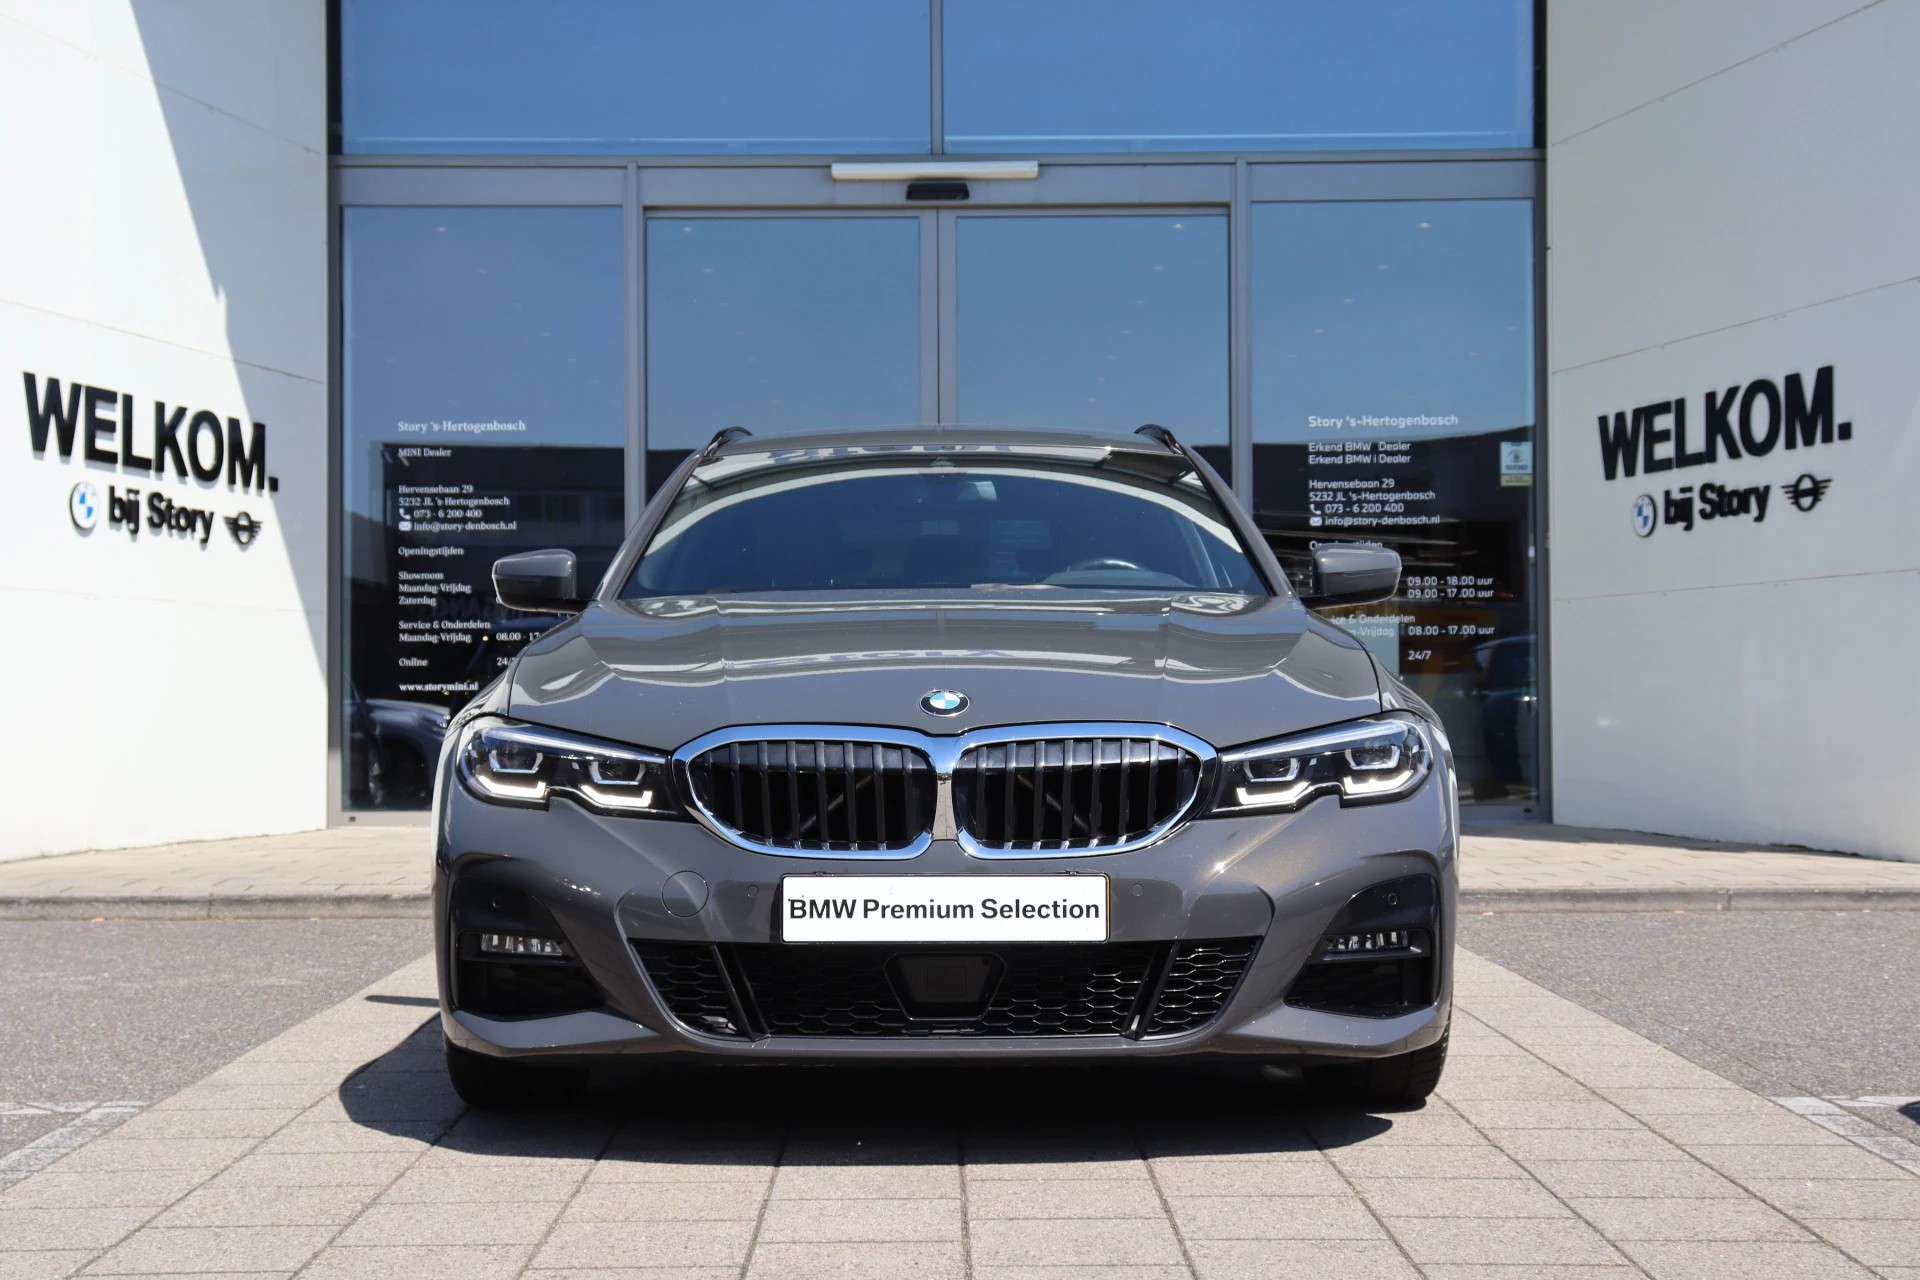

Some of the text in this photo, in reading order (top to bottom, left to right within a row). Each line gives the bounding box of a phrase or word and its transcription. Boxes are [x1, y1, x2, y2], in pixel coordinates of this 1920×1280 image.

[398, 420, 527, 433] Story 's-Hertogenbosch
[1307, 414, 1459, 428] Story 's-Hertogenbosch
[1598, 365, 1853, 481] WELKOM.
[22, 371, 279, 492] WELKOM.
[398, 447, 452, 457] MINI Dealer
[1308, 441, 1411, 452] Erkend BMW Dealer
[1308, 455, 1343, 464] Erkend
[1345, 454, 1371, 464] BMW
[1379, 454, 1411, 463] Dealer
[398, 484, 474, 494] Hervensebaan 29
[1308, 478, 1395, 489] Hervensebaan 29
[398, 497, 421, 506] 5232
[422, 496, 434, 506] JL
[1308, 491, 1334, 501] 5232
[1335, 491, 1347, 501] JL
[1324, 503, 1344, 513] 073
[1352, 503, 1360, 513] 6
[1361, 503, 1382, 513] 200
[1383, 502, 1404, 513] 400
[1664, 482, 1772, 531] bij Story
[108, 484, 214, 544] bij Story
[413, 509, 431, 518] 073
[438, 509, 445, 518] 6
[446, 509, 463, 518] 200
[464, 509, 483, 518] 400
[398, 546, 464, 558] Openingstijden
[398, 571, 444, 580] Showroom
[1407, 576, 1438, 586] 09.00
[1447, 576, 1475, 585] 18.00
[1477, 577, 1494, 585] uur
[1407, 589, 1438, 598] 09.00
[1447, 588, 1475, 598] 17.00
[1477, 589, 1494, 597] uur
[398, 596, 437, 606] Zaterdag
[1358, 613, 1416, 624] Onderdelen
[398, 620, 431, 630] Service
[441, 620, 491, 629] Onderdelen
[1408, 625, 1439, 636] 08.00
[1448, 625, 1476, 635] 17.00
[1478, 626, 1495, 635] uur
[495, 632, 521, 641] 08.00
[1408, 650, 1432, 661] 24/7
[398, 657, 428, 667] Online
[399, 681, 479, 692] www.storymini.nl
[789, 898, 1100, 919] BMW Premium Selection
